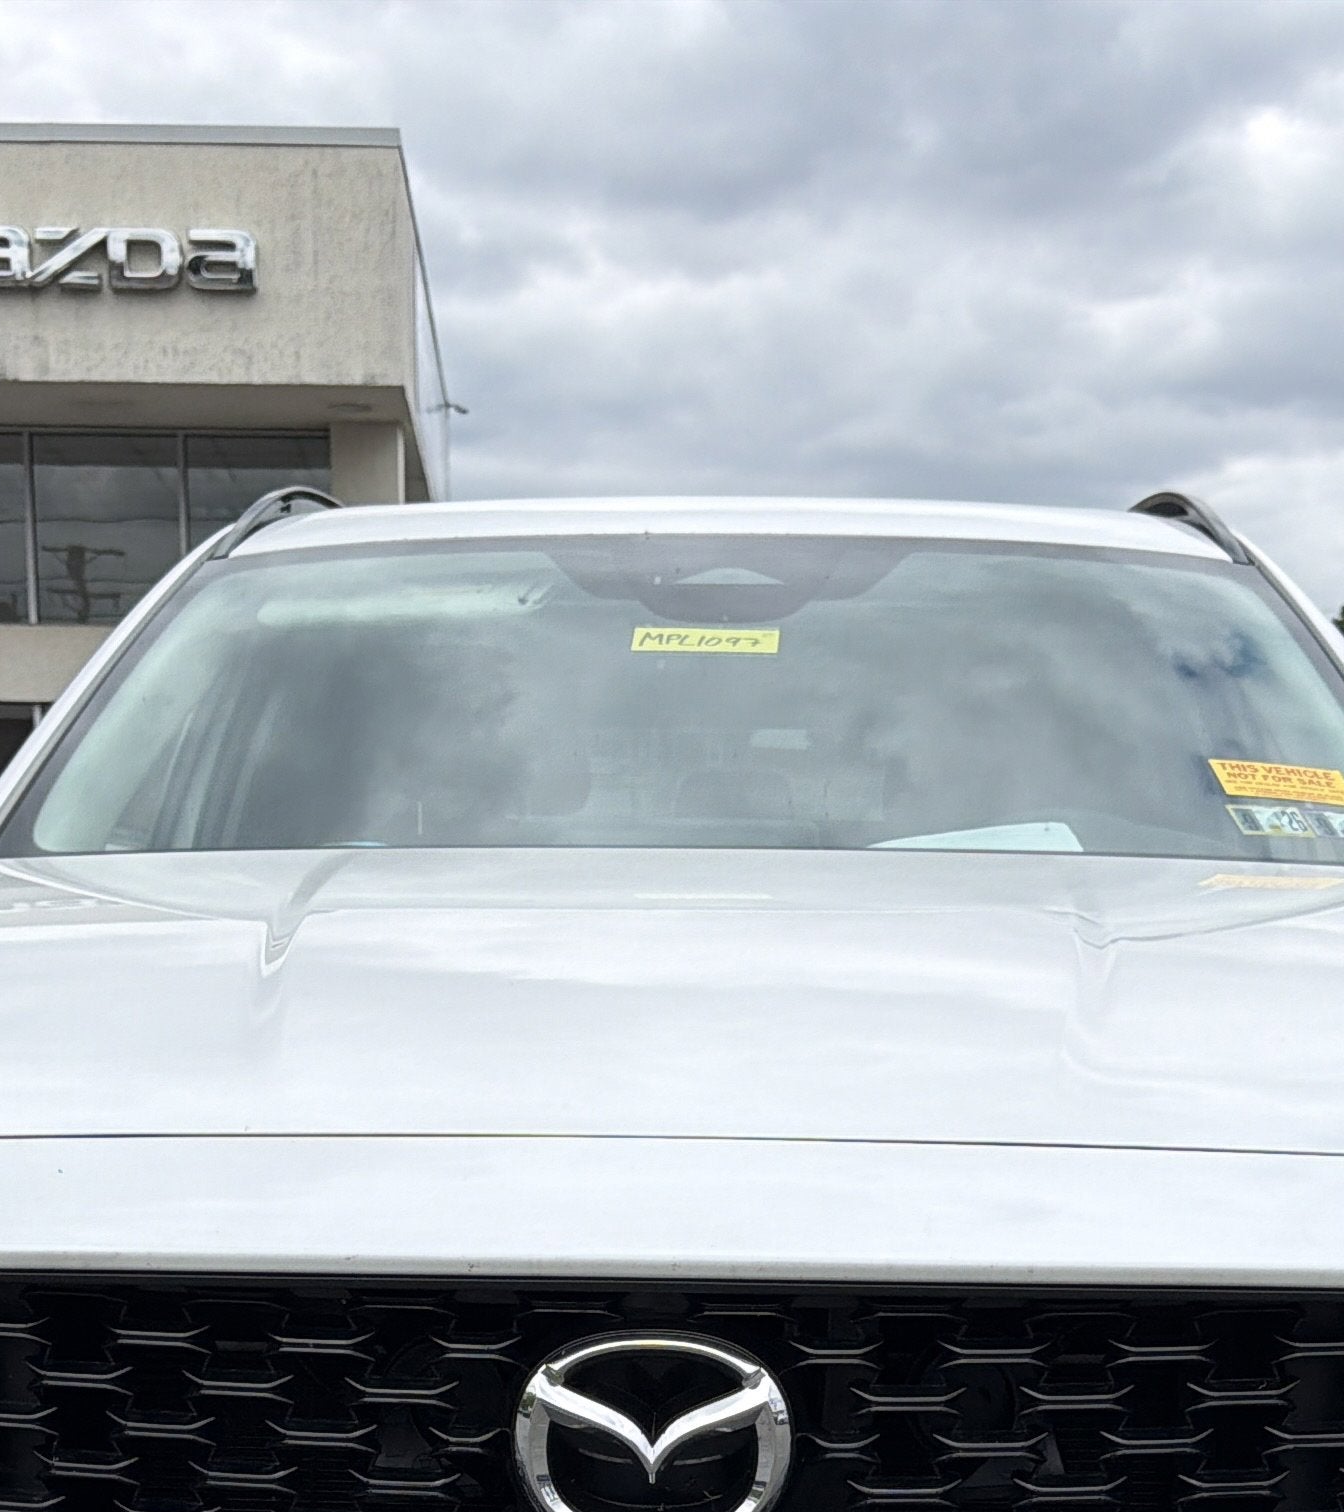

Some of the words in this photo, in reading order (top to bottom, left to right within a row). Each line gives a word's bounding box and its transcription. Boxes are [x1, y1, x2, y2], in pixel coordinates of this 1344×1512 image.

[1217, 762, 1261, 774] THIS
[1262, 764, 1335, 781] VEHICLE
[1226, 772, 1258, 782] NOT
[1261, 774, 1293, 784] FOR
[1296, 778, 1336, 789] SALE
